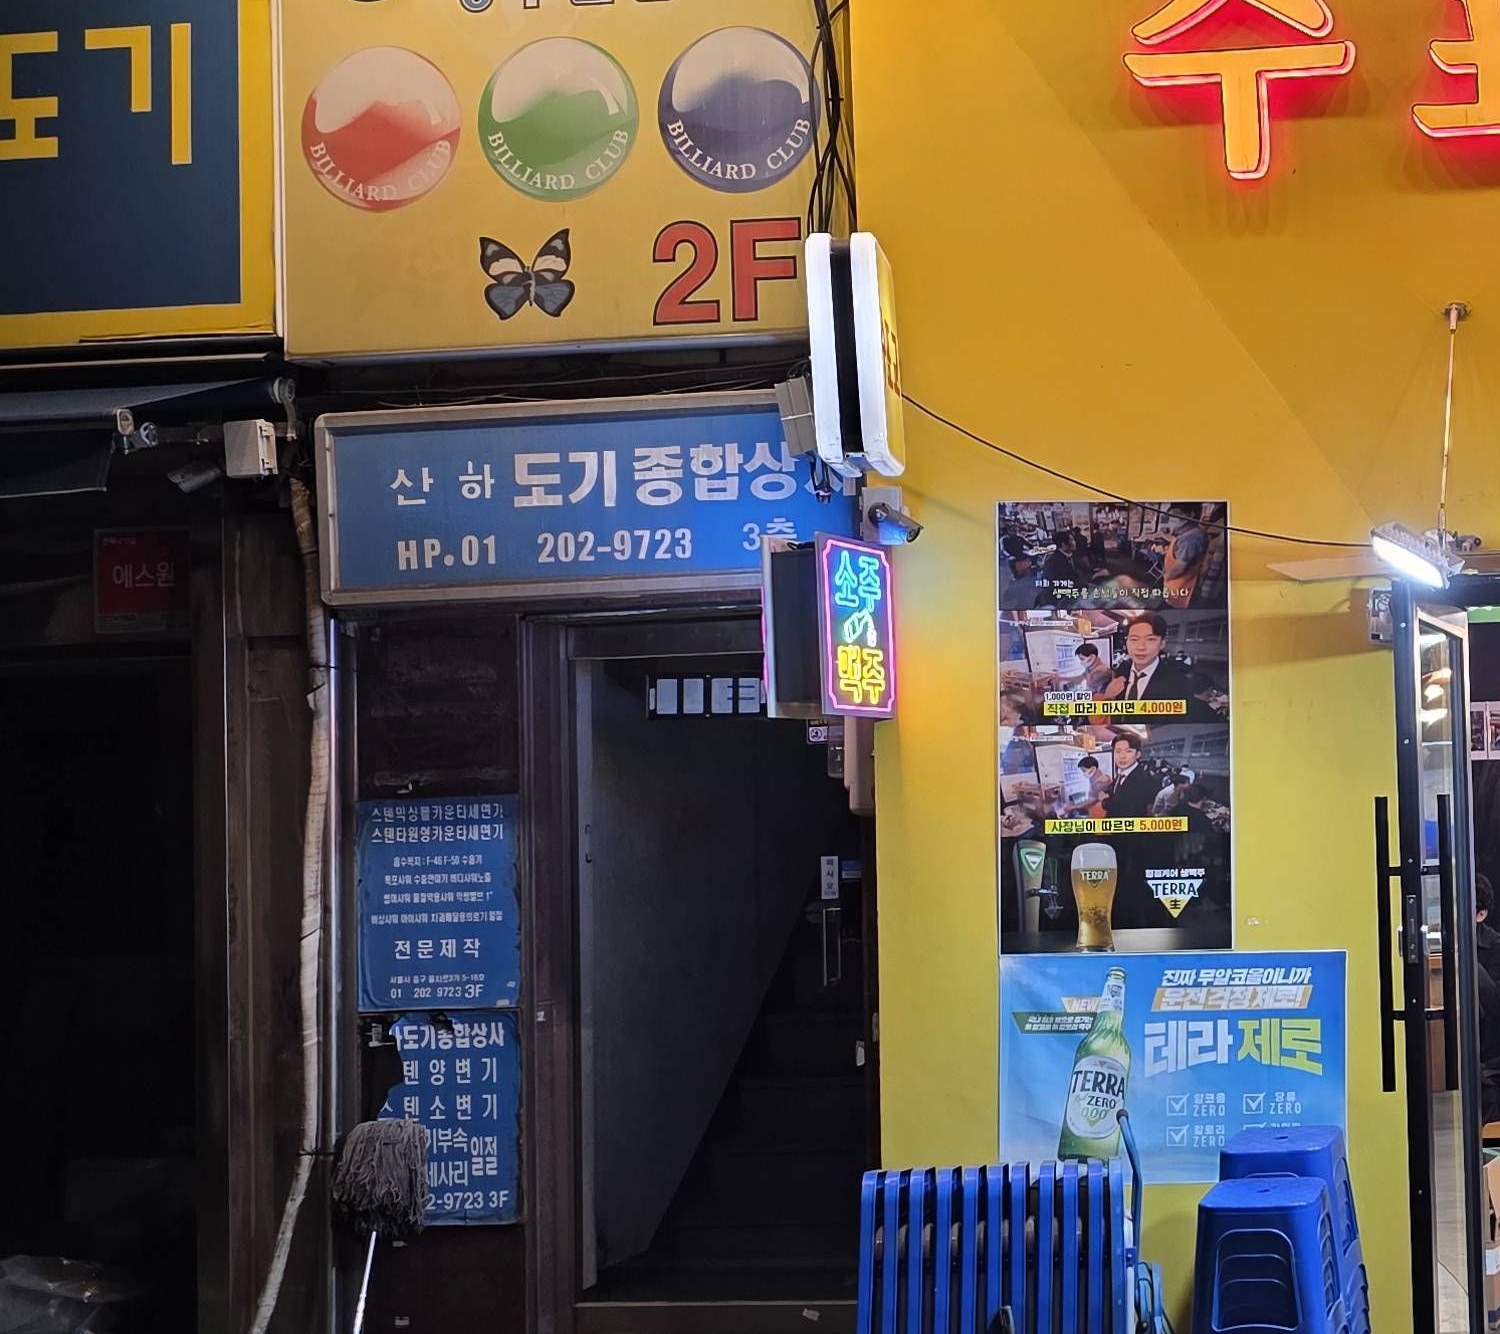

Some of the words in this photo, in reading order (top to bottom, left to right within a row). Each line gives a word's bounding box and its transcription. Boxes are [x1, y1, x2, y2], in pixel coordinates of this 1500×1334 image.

[666, 118, 756, 180] BILLIARD
[767, 117, 812, 171] CLUB
[488, 130, 576, 191] BILLIARD
[585, 128, 629, 182] CLUB
[310, 141, 398, 201] BILLIARD
[407, 139, 452, 193] CLUB
[652, 216, 802, 327] 2F
[537, 528, 692, 564] 202-9723
[835, 548, 882, 615] 소주
[836, 643, 886, 706] 맥주
[1047, 702, 1069, 714] 직접
[1074, 702, 1097, 714] 따라
[1101, 702, 1135, 714] 마시면
[1051, 820, 1096, 833] 사장님이
[1101, 820, 1135, 832] 따르면
[1080, 870, 1109, 882] TERRA
[1152, 881, 1196, 896] TERRA
[1162, 969, 1196, 986] 진짜
[1198, 966, 1312, 986] 무알코올이니까
[414, 987, 432, 998] 202
[437, 986, 462, 998] 9723
[465, 984, 484, 998] 3F
[1071, 999, 1098, 1012] NEW
[1144, 1019, 1233, 1079] 테라
[1237, 1018, 1322, 1076] 제로
[1072, 1069, 1125, 1101] TERRA
[1086, 1094, 1117, 1109] ZERO
[1269, 1103, 1302, 1115] ZERO
[1193, 1105, 1226, 1117] ZERO
[1193, 1135, 1226, 1148] ZERO
[489, 1190, 510, 1208] 3F
